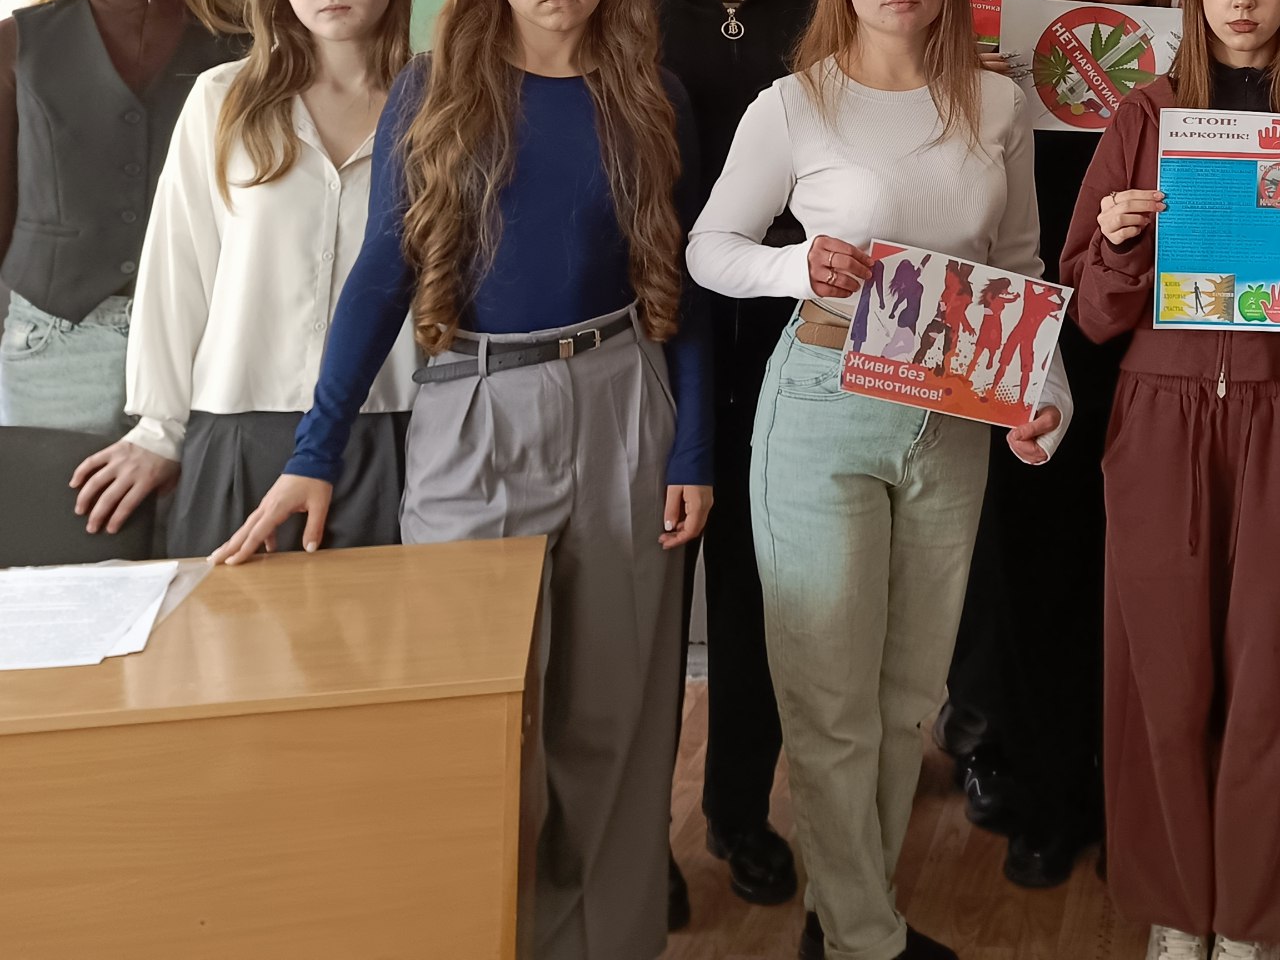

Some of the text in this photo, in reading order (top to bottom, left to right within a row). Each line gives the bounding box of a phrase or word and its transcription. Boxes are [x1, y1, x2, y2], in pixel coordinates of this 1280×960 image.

[1052, 22, 1079, 51] НЕТ
[1073, 50, 1120, 112] НАРКОТИКА
[1182, 116, 1237, 126] СТОП!
[1169, 131, 1250, 140] НАРКОТИК!
[848, 354, 926, 381] Живи без
[846, 372, 943, 401] наркотиков!
